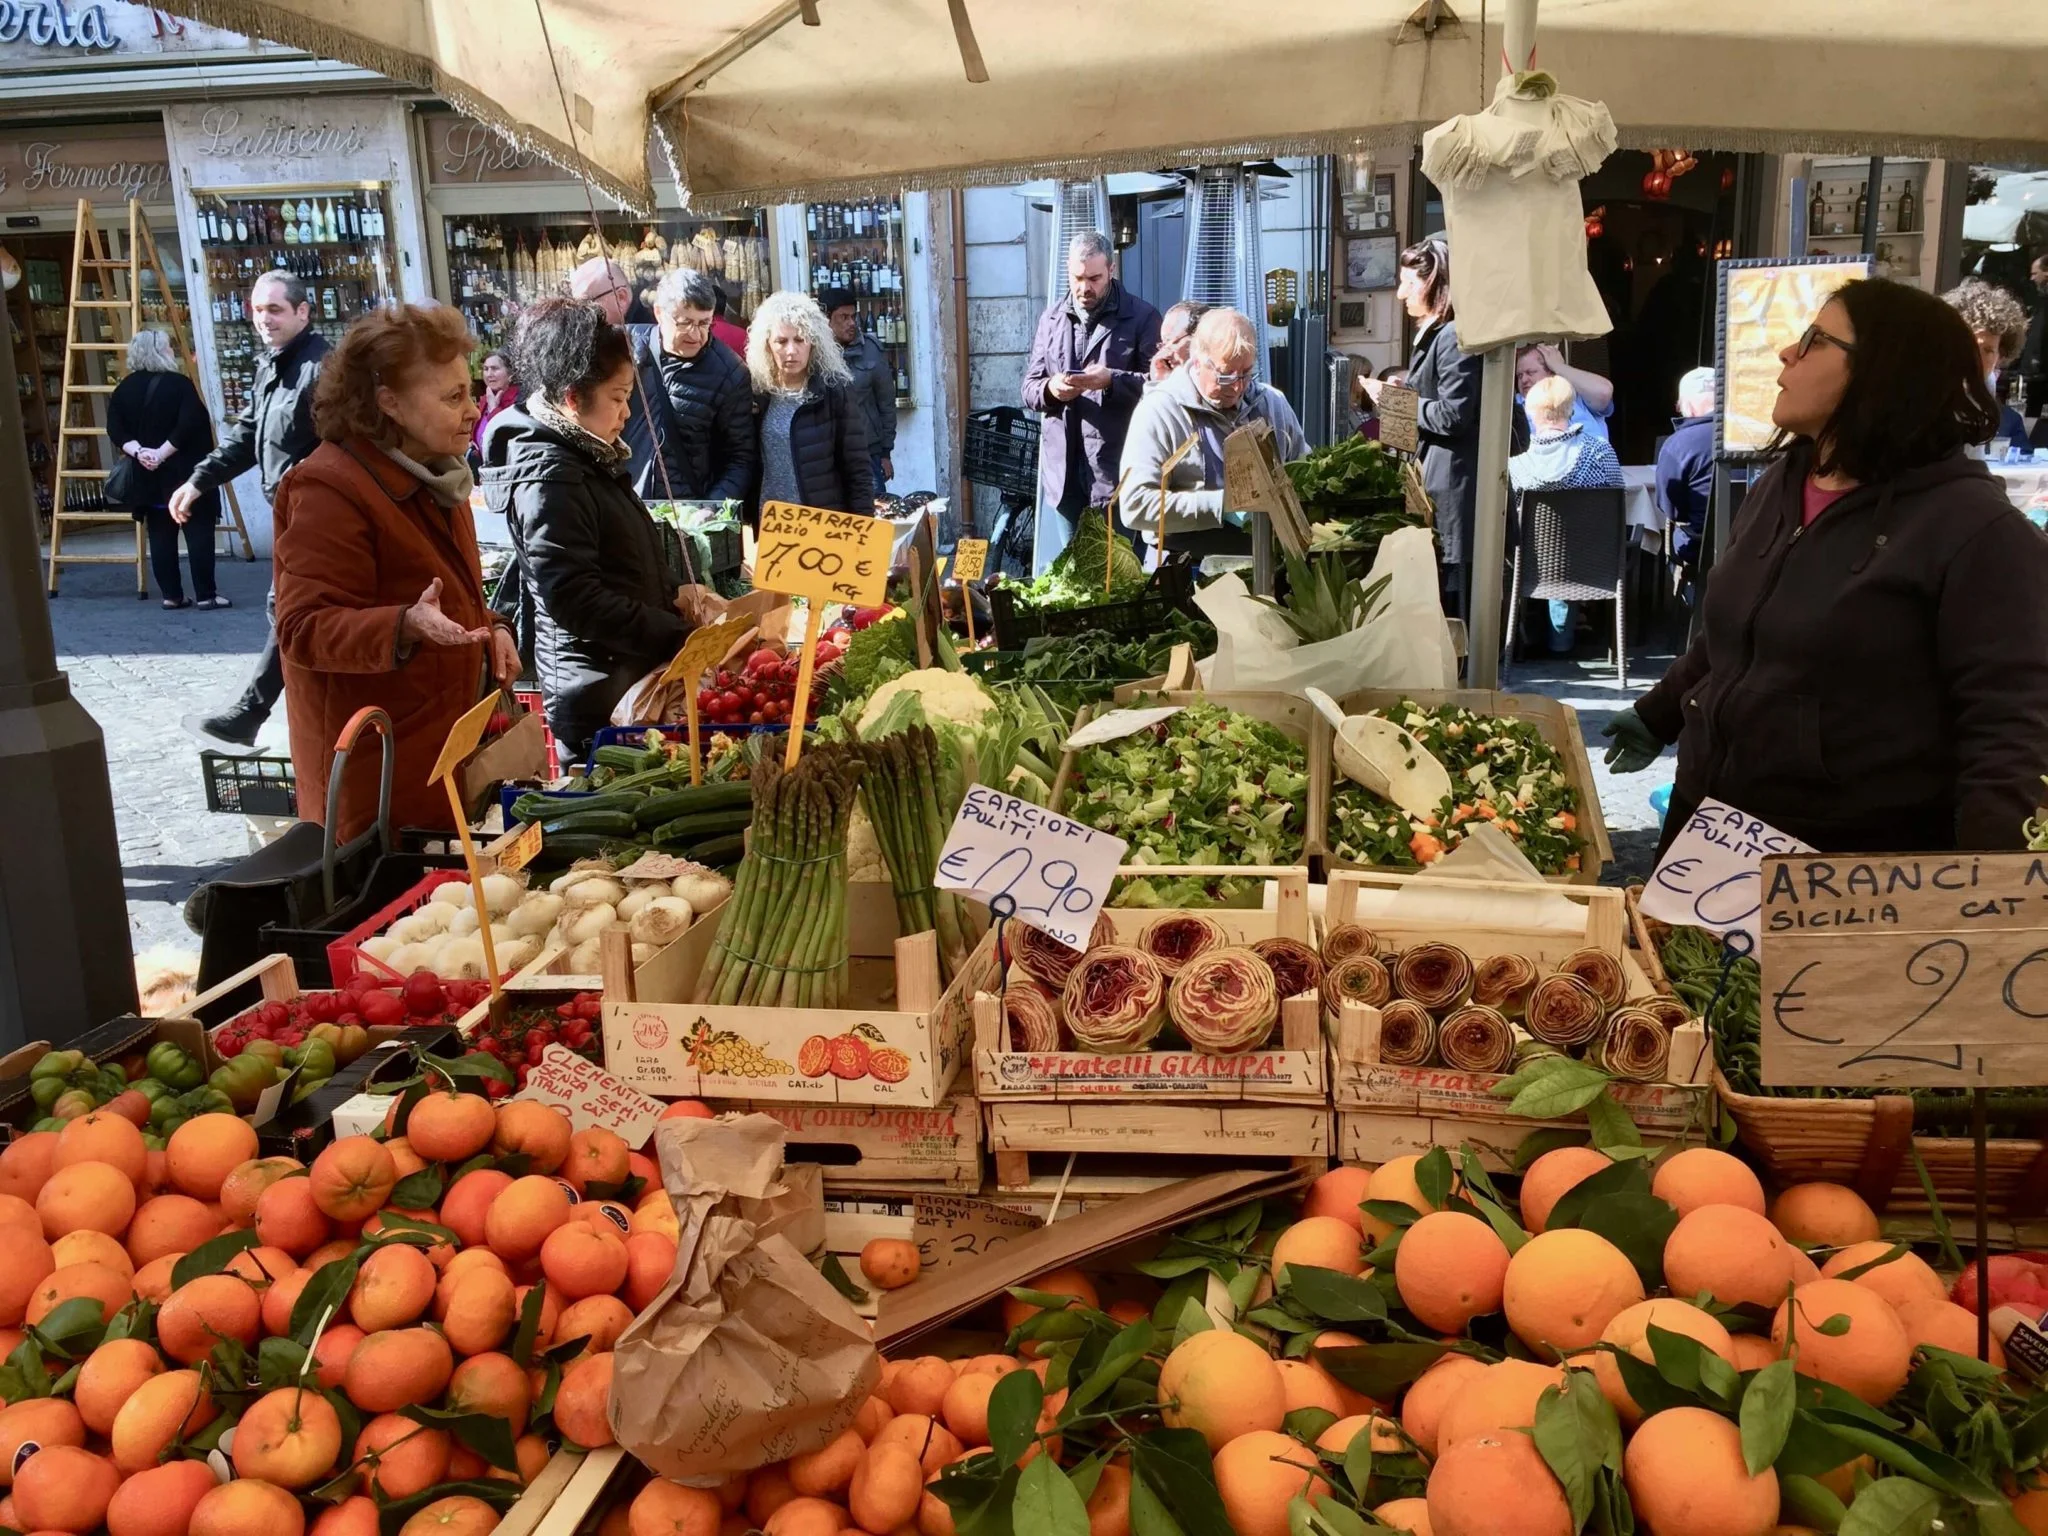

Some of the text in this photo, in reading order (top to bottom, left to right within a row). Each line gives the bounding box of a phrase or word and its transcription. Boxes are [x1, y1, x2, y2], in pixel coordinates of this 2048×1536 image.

[199, 106, 367, 158] Latticini
[761, 521, 809, 538] LAZIO
[824, 530, 854, 542] CAT
[763, 504, 875, 533] ASPARAGI
[760, 540, 873, 582] 7,00 €
[831, 581, 863, 601] KG
[961, 803, 1037, 841] PULITI
[967, 789, 1096, 844] CARCIOFI
[938, 846, 976, 882] €
[1655, 858, 1704, 895] €
[1766, 858, 1981, 905] ARANCI
[1768, 896, 2027, 932] SICILIA CAT
[1772, 960, 1845, 1045] €
[1041, 1054, 1153, 1076] Fratelli
[530, 1074, 573, 1101] ITALIA
[581, 1102, 610, 1118] CAT
[538, 1063, 589, 1093] SENZA
[595, 1094, 644, 1122] SEMI
[547, 1050, 666, 1118] CLEMENTINI
[873, 1083, 897, 1093] CAL.
[812, 1109, 956, 1138] VERDICCHIO
[1203, 1129, 1247, 1139] ITALIA
[915, 1203, 972, 1221] TARDIVI
[915, 1216, 939, 1226] CAT
[917, 1238, 939, 1267] €
[676, 1379, 728, 1463] Arrivederci
[708, 1398, 744, 1459] grazie
